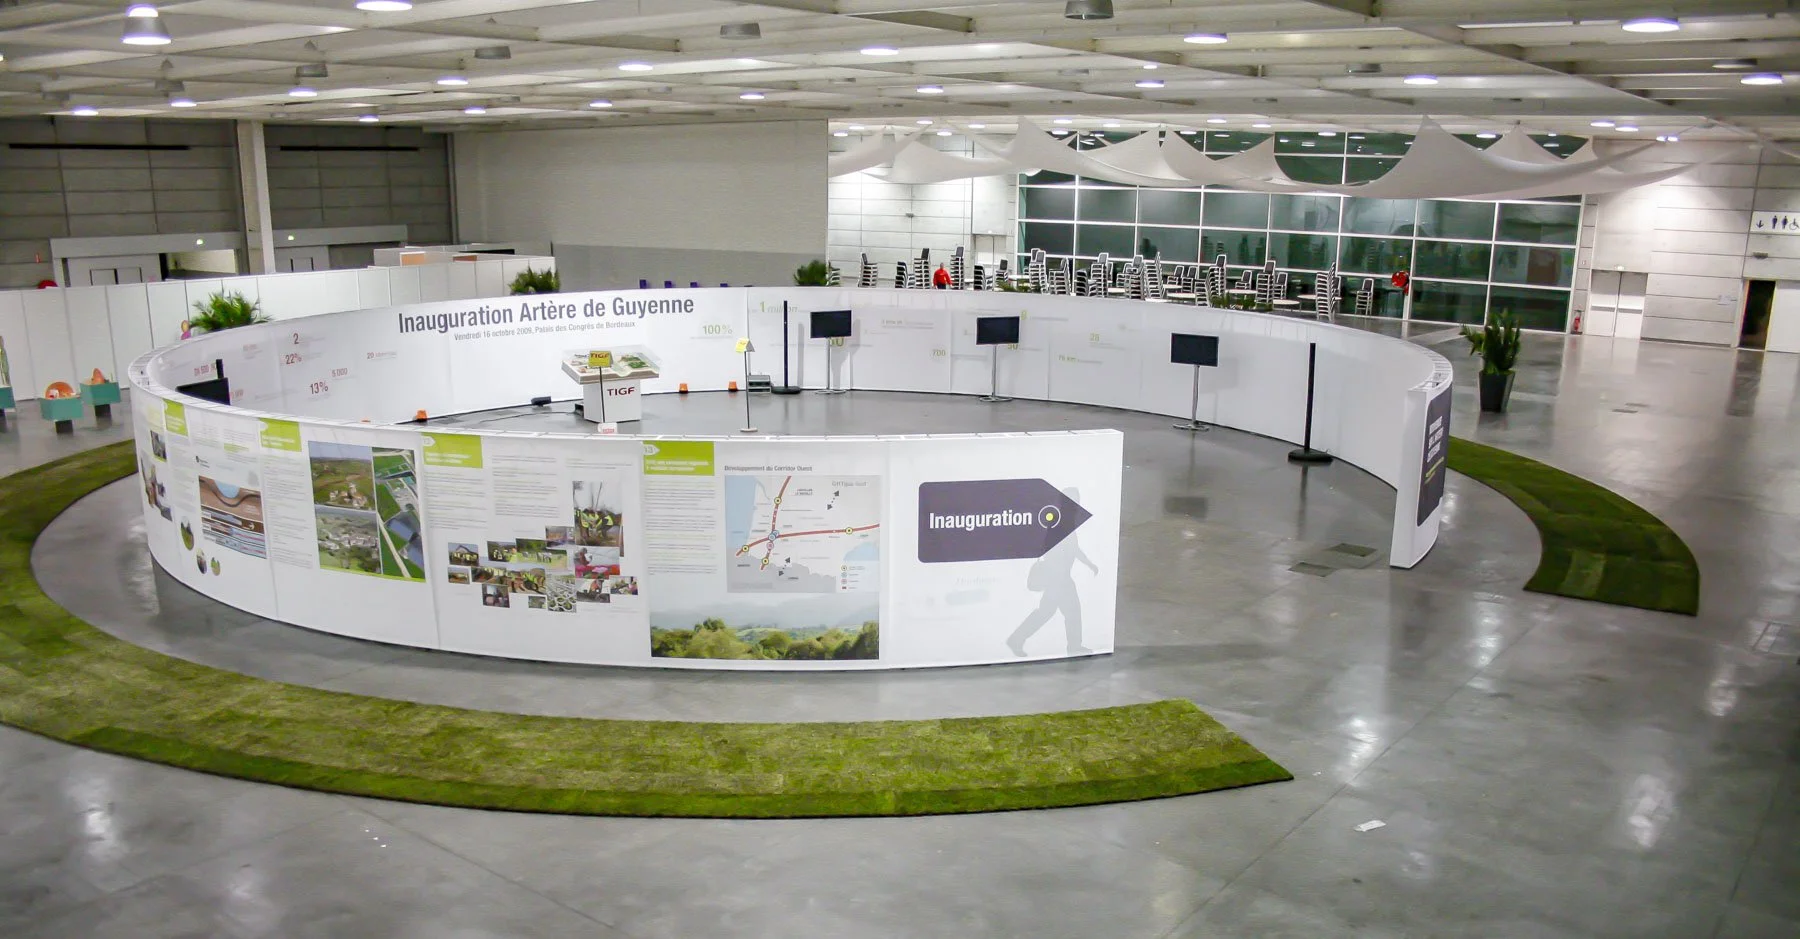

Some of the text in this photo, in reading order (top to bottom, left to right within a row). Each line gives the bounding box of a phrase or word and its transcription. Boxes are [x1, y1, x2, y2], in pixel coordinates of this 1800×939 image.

[759, 301, 766, 313] 1
[398, 296, 695, 334] Inauguration Artère de Guyenne
[454, 331, 482, 341] Vendredi
[482, 331, 491, 339] 16
[491, 328, 516, 338] octobre
[535, 324, 554, 334] Palais
[555, 323, 567, 332] des
[568, 322, 595, 332] Congrès
[595, 321, 605, 330] de
[605, 320, 636, 330] Bordeaux
[293, 332, 300, 345] 2
[285, 352, 302, 365] 22%
[310, 380, 329, 395] 13%
[607, 386, 635, 397] TIGF
[929, 509, 1033, 532] Inauguration
